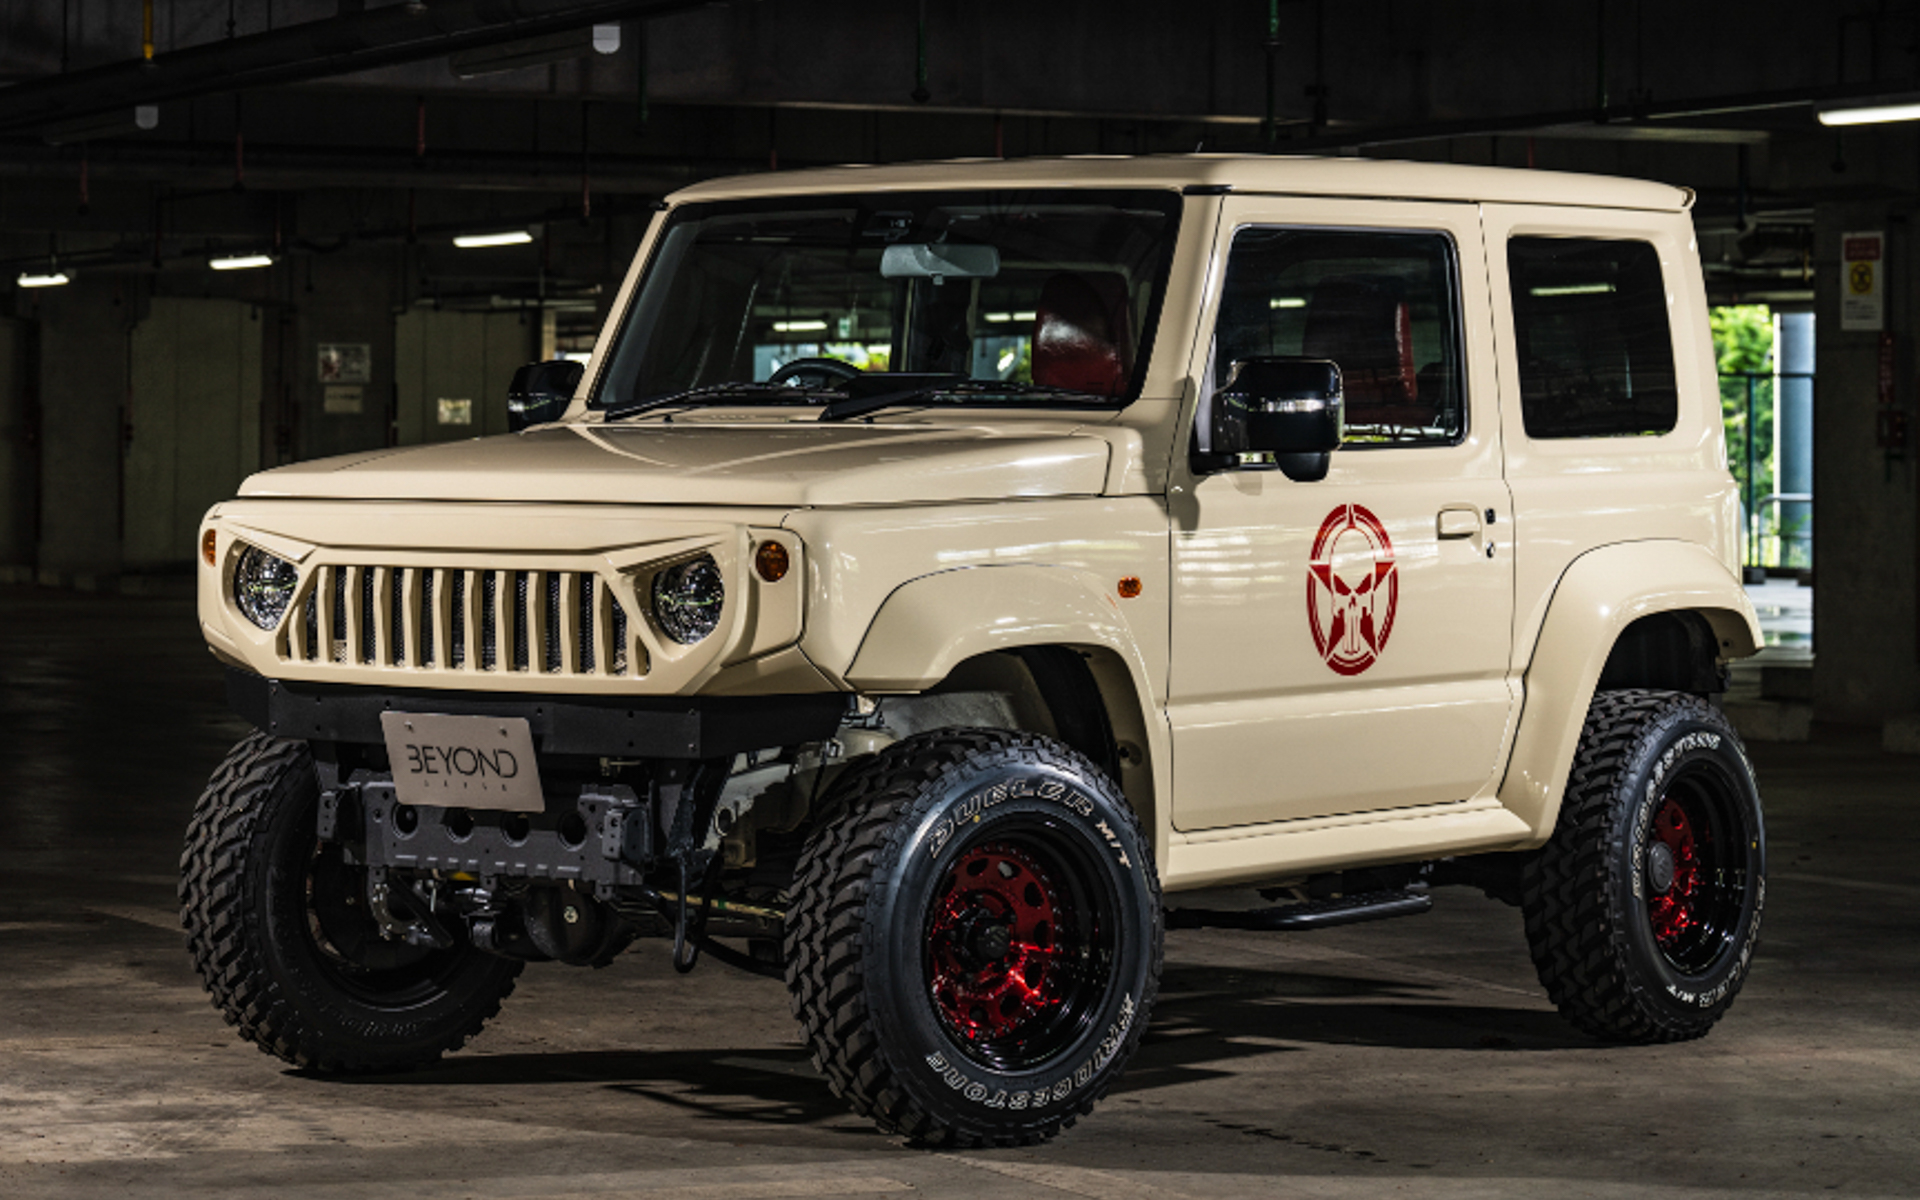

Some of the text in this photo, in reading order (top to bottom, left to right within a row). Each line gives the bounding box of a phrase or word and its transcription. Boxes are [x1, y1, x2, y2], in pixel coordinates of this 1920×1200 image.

[406, 744, 518, 778] BEYOND
[929, 779, 1133, 870] DUELER M/T
[925, 993, 1135, 1110] BRIDGESTONE
